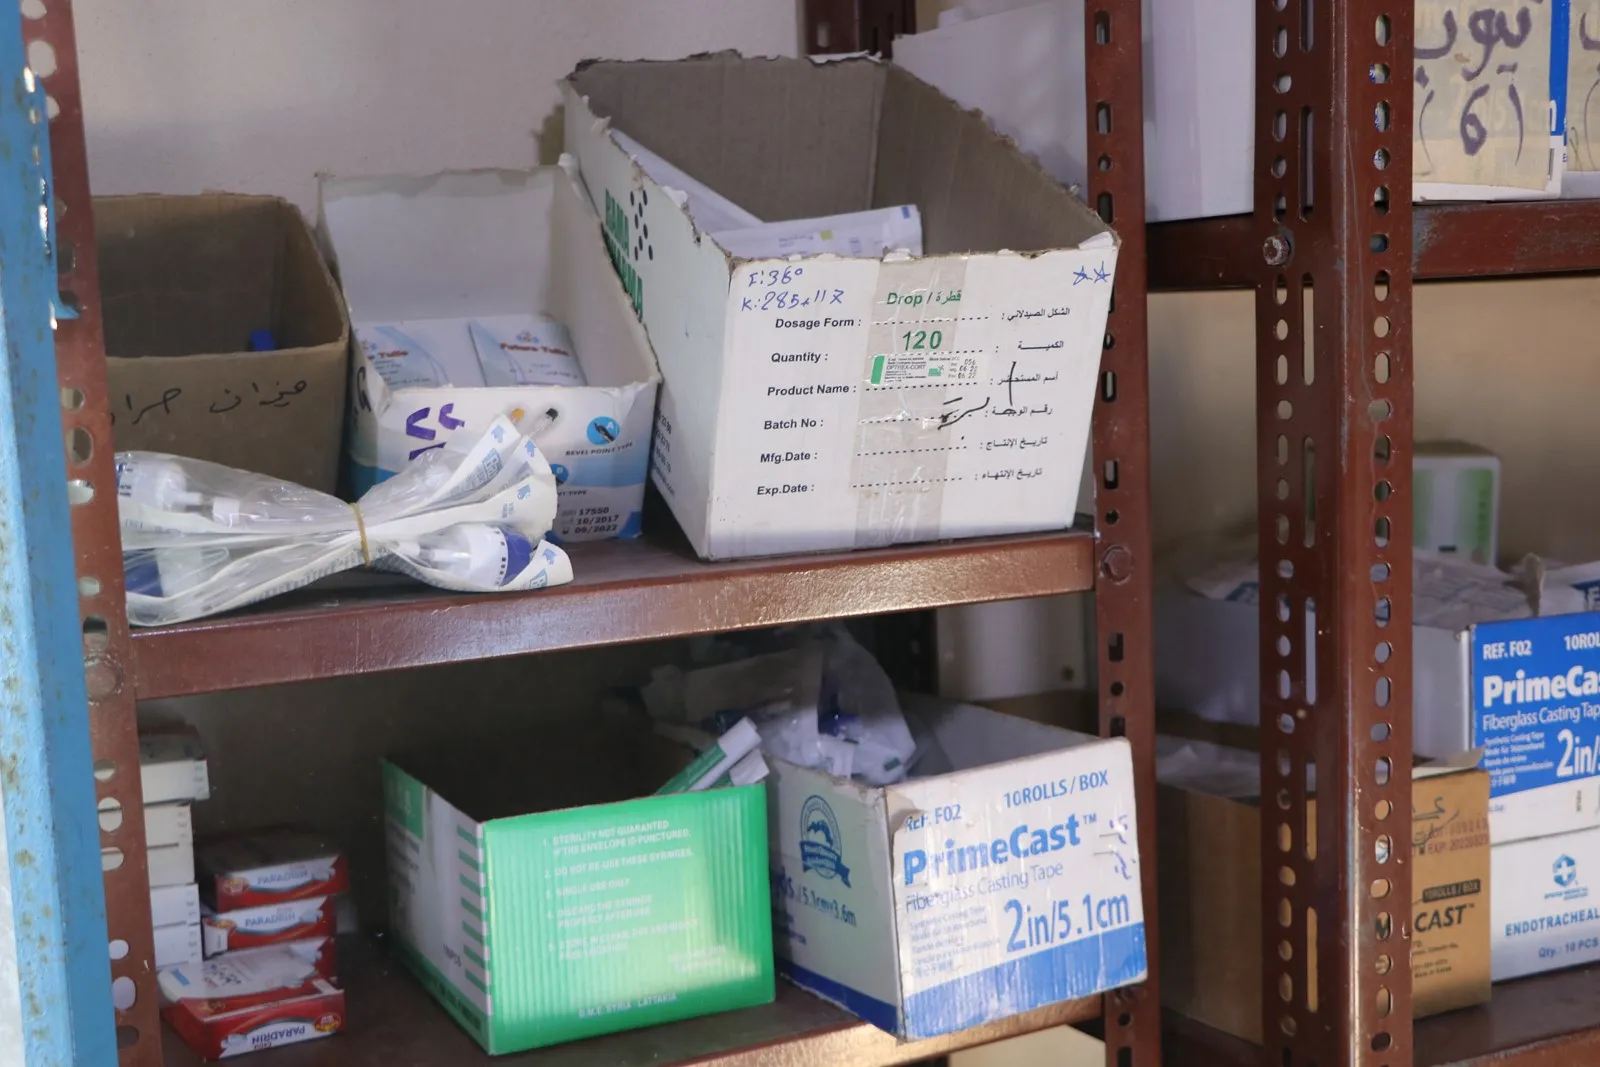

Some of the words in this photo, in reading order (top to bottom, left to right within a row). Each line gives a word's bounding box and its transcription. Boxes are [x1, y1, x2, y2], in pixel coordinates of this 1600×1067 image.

[887, 292, 922, 307] Drop
[936, 290, 962, 305] قطرة
[1007, 308, 1046, 321] الصيدلاني
[1047, 307, 1070, 318] الشكل
[775, 317, 820, 330] Dosage
[823, 317, 854, 328] Form
[902, 330, 942, 351] 120
[771, 352, 821, 363] Quantity
[767, 385, 814, 397] Product
[816, 384, 850, 394] Name
[1030, 403, 1053, 416] رقم
[764, 419, 798, 430] Batch
[801, 418, 817, 428] No
[1019, 436, 1048, 449] تاريخ
[565, 448, 589, 456] BEVEL
[760, 451, 811, 464] Mfg.Date
[1016, 468, 1042, 480] تاريخ
[757, 483, 809, 496] Exp.Date
[576, 514, 620, 526] 10/2017
[1483, 642, 1508, 660] REF.
[1509, 639, 1533, 657] F02
[1483, 665, 1600, 707] PrimeCa
[1483, 710, 1538, 732] Fiberglass
[1539, 705, 1580, 723] Casting
[934, 804, 963, 824] F02
[1029, 861, 1064, 882] Tape
[244, 912, 297, 928] PARADRIN
[251, 1026, 306, 1044] PARADRIN
